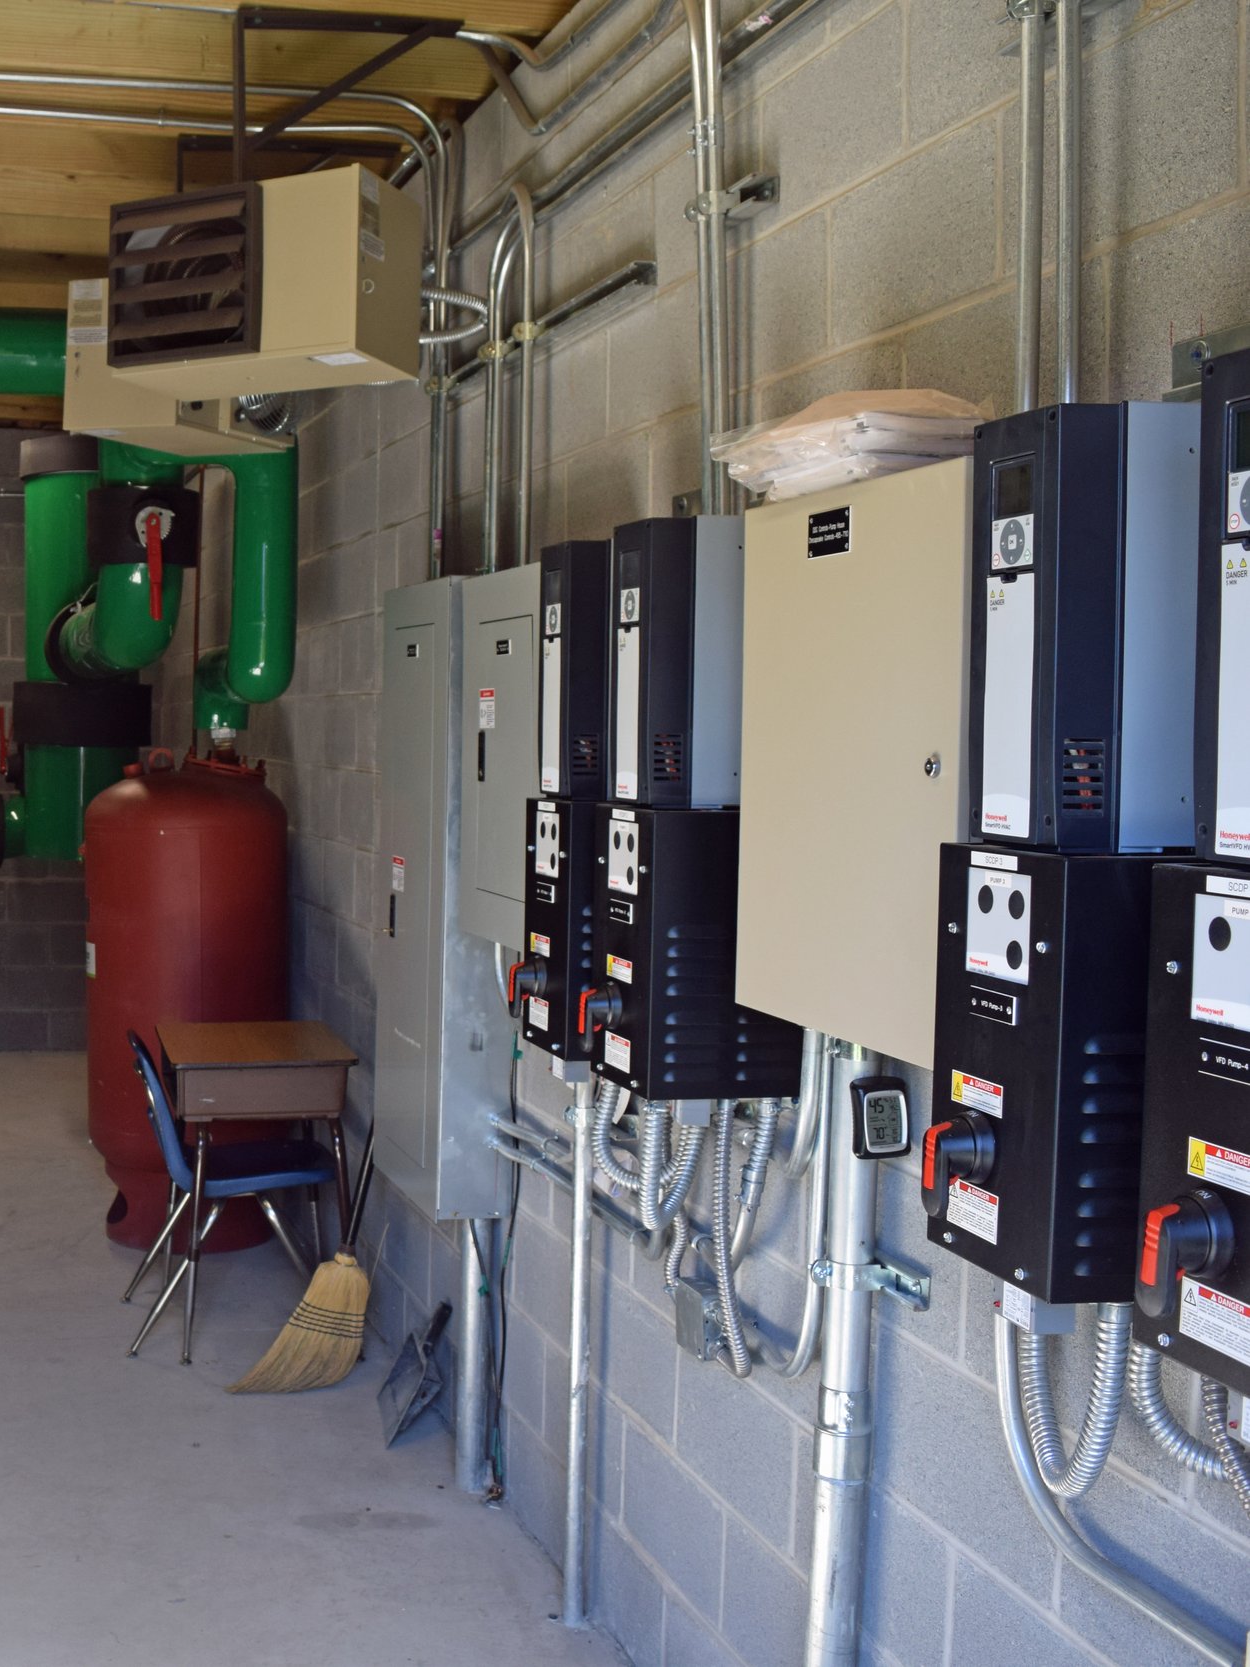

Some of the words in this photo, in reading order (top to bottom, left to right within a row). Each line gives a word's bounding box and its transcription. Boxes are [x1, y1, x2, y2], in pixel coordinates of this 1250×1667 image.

[1225, 569, 1248, 579] DANGER
[985, 812, 1008, 822] Honeywell
[1228, 881, 1249, 892] SCDP
[1231, 906, 1249, 916] PUMP
[969, 956, 989, 967] Honeywell
[1196, 1003, 1224, 1017] Honeywell
[1215, 1055, 1227, 1065] VFD
[1227, 1058, 1249, 1071] Pump-4
[974, 1079, 995, 1093] DANGER
[971, 1187, 990, 1202] DANGER
[1217, 1295, 1245, 1315] DANGER
